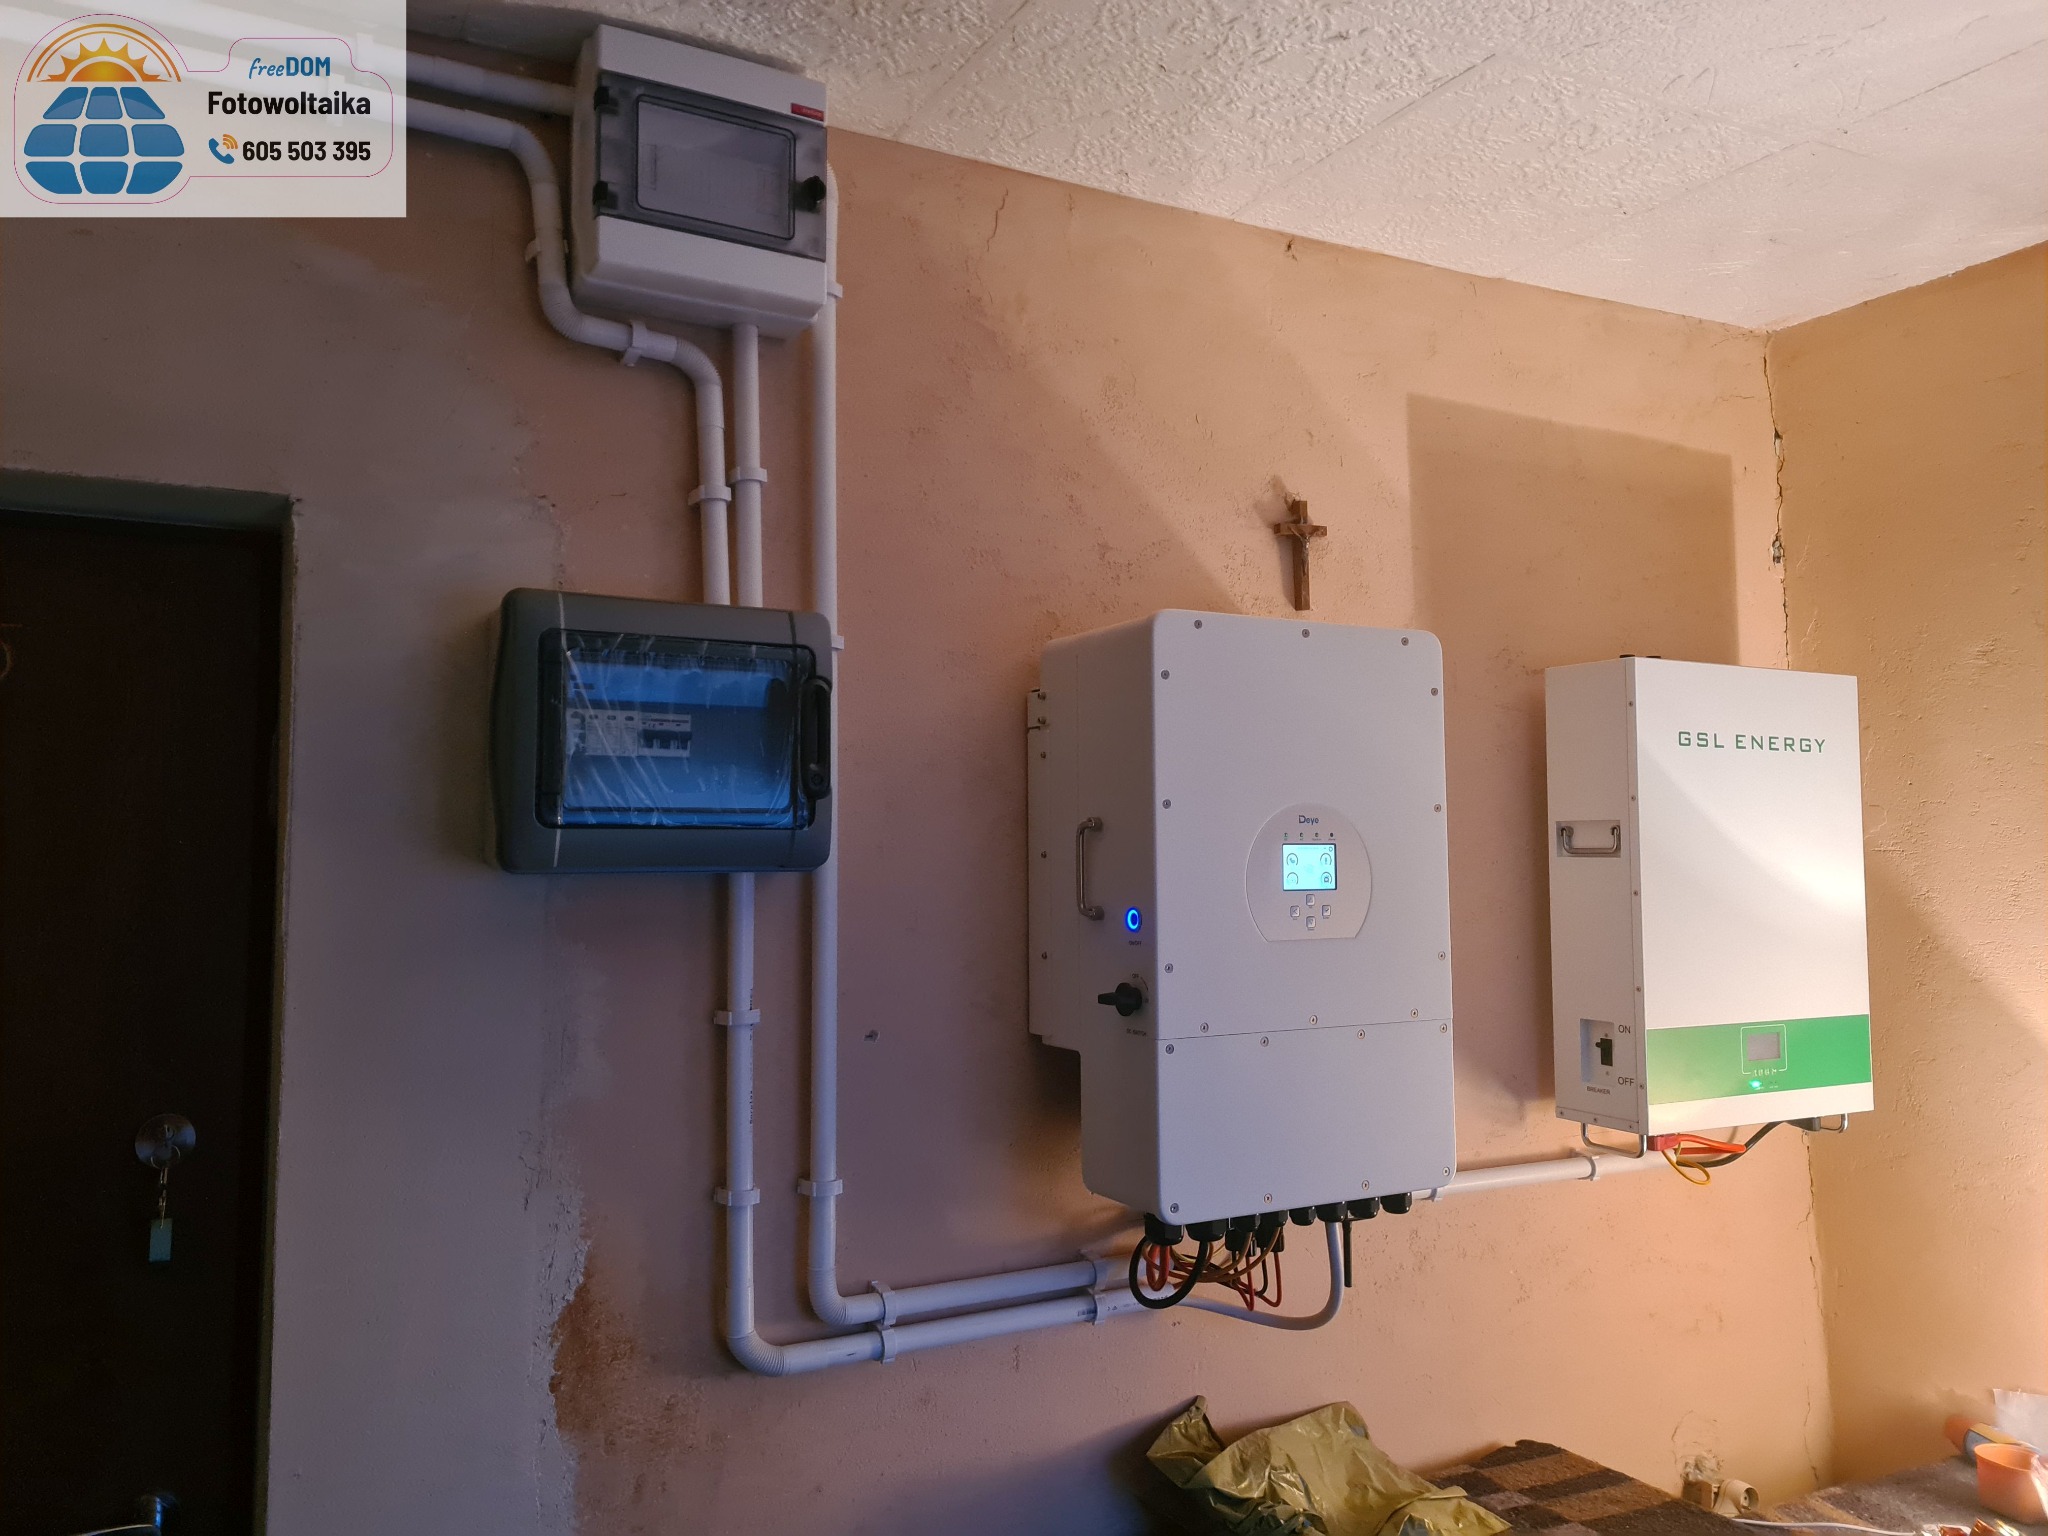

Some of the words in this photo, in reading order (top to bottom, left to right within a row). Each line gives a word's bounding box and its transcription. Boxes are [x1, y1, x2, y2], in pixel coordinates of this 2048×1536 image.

[1678, 731, 1725, 749] GSL
[1735, 734, 1826, 753] ENERGY
[1299, 815, 1319, 825] Deye
[1618, 1024, 1631, 1034] ON
[1617, 1076, 1635, 1087] OFF
[1586, 1086, 1611, 1096] BREAKER
